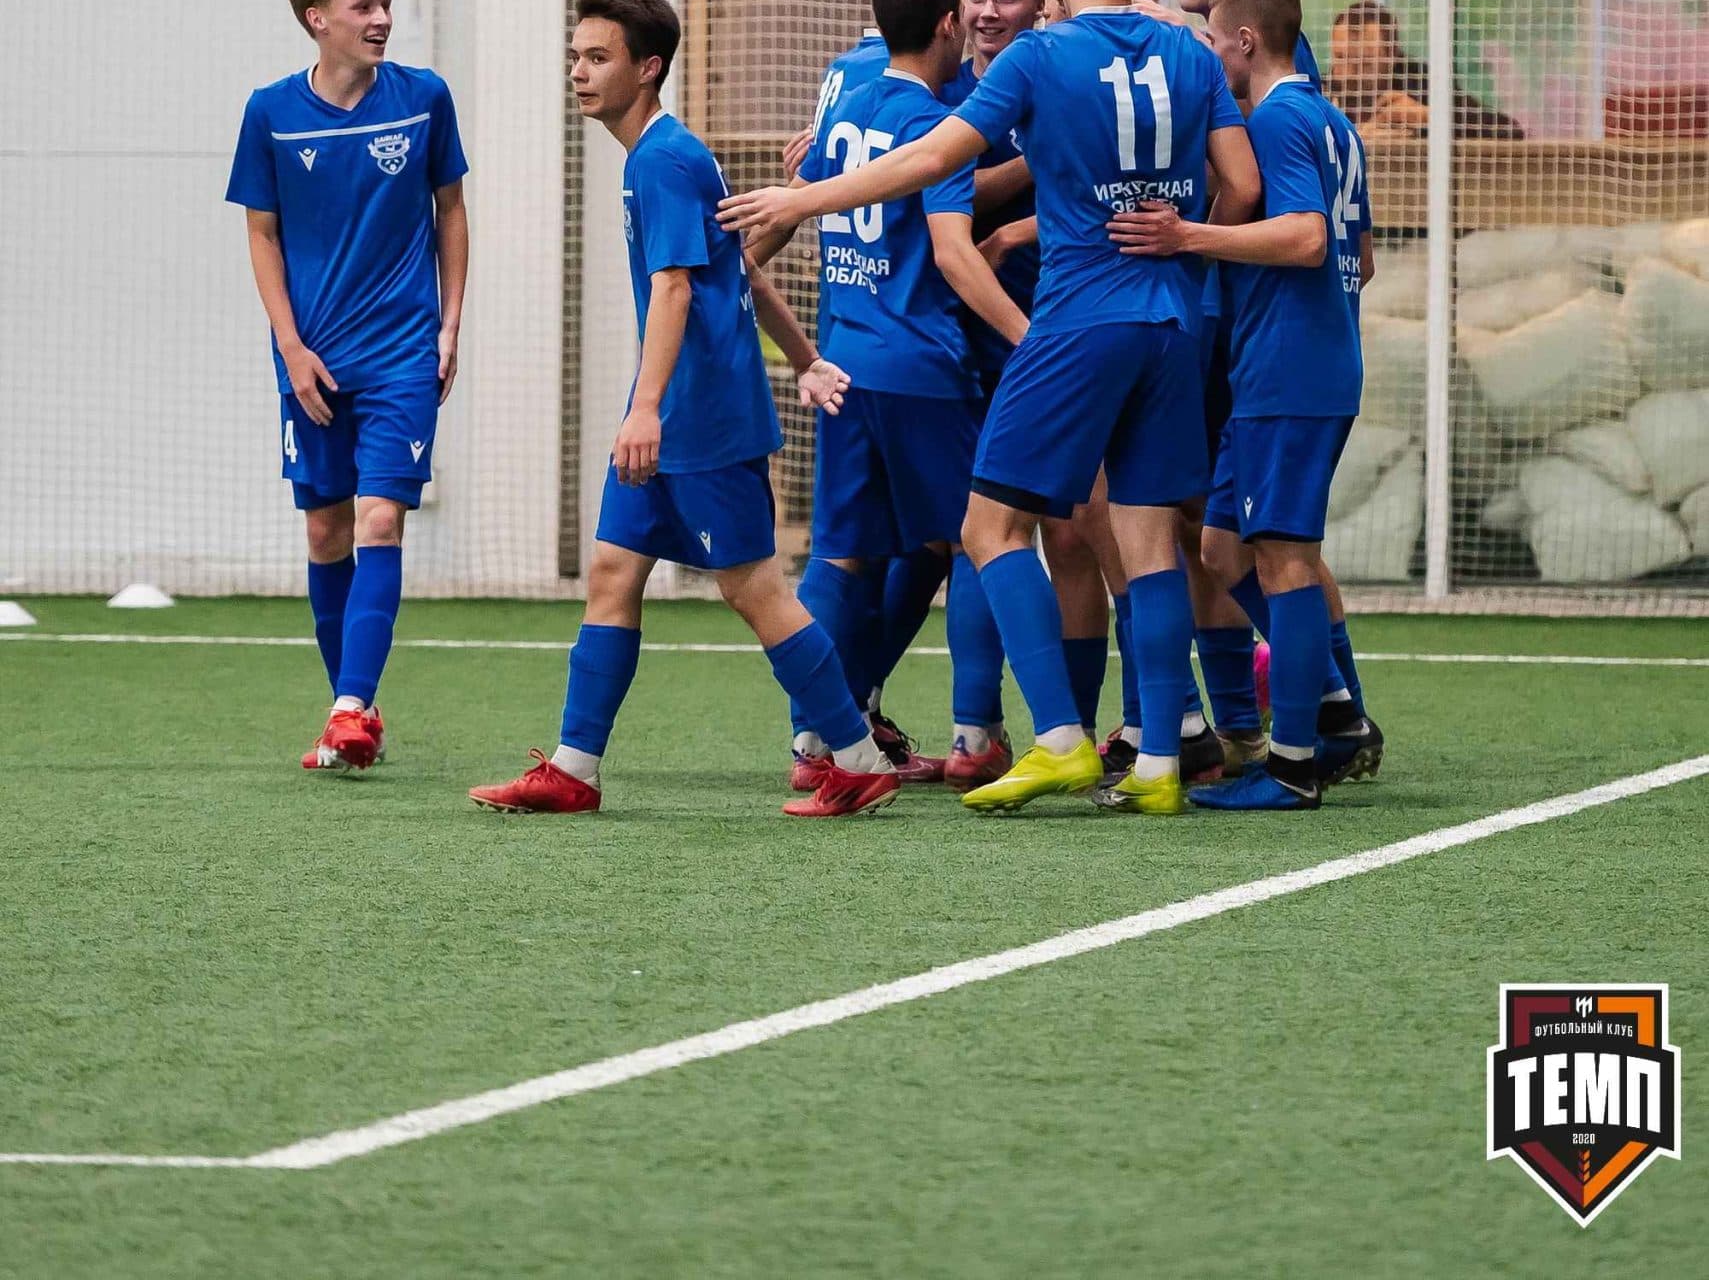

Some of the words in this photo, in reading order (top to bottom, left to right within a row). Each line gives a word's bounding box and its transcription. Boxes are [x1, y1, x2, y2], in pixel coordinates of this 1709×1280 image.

[1099, 55, 1172, 170] 11
[821, 121, 895, 244] 25
[284, 420, 298, 463] 4
